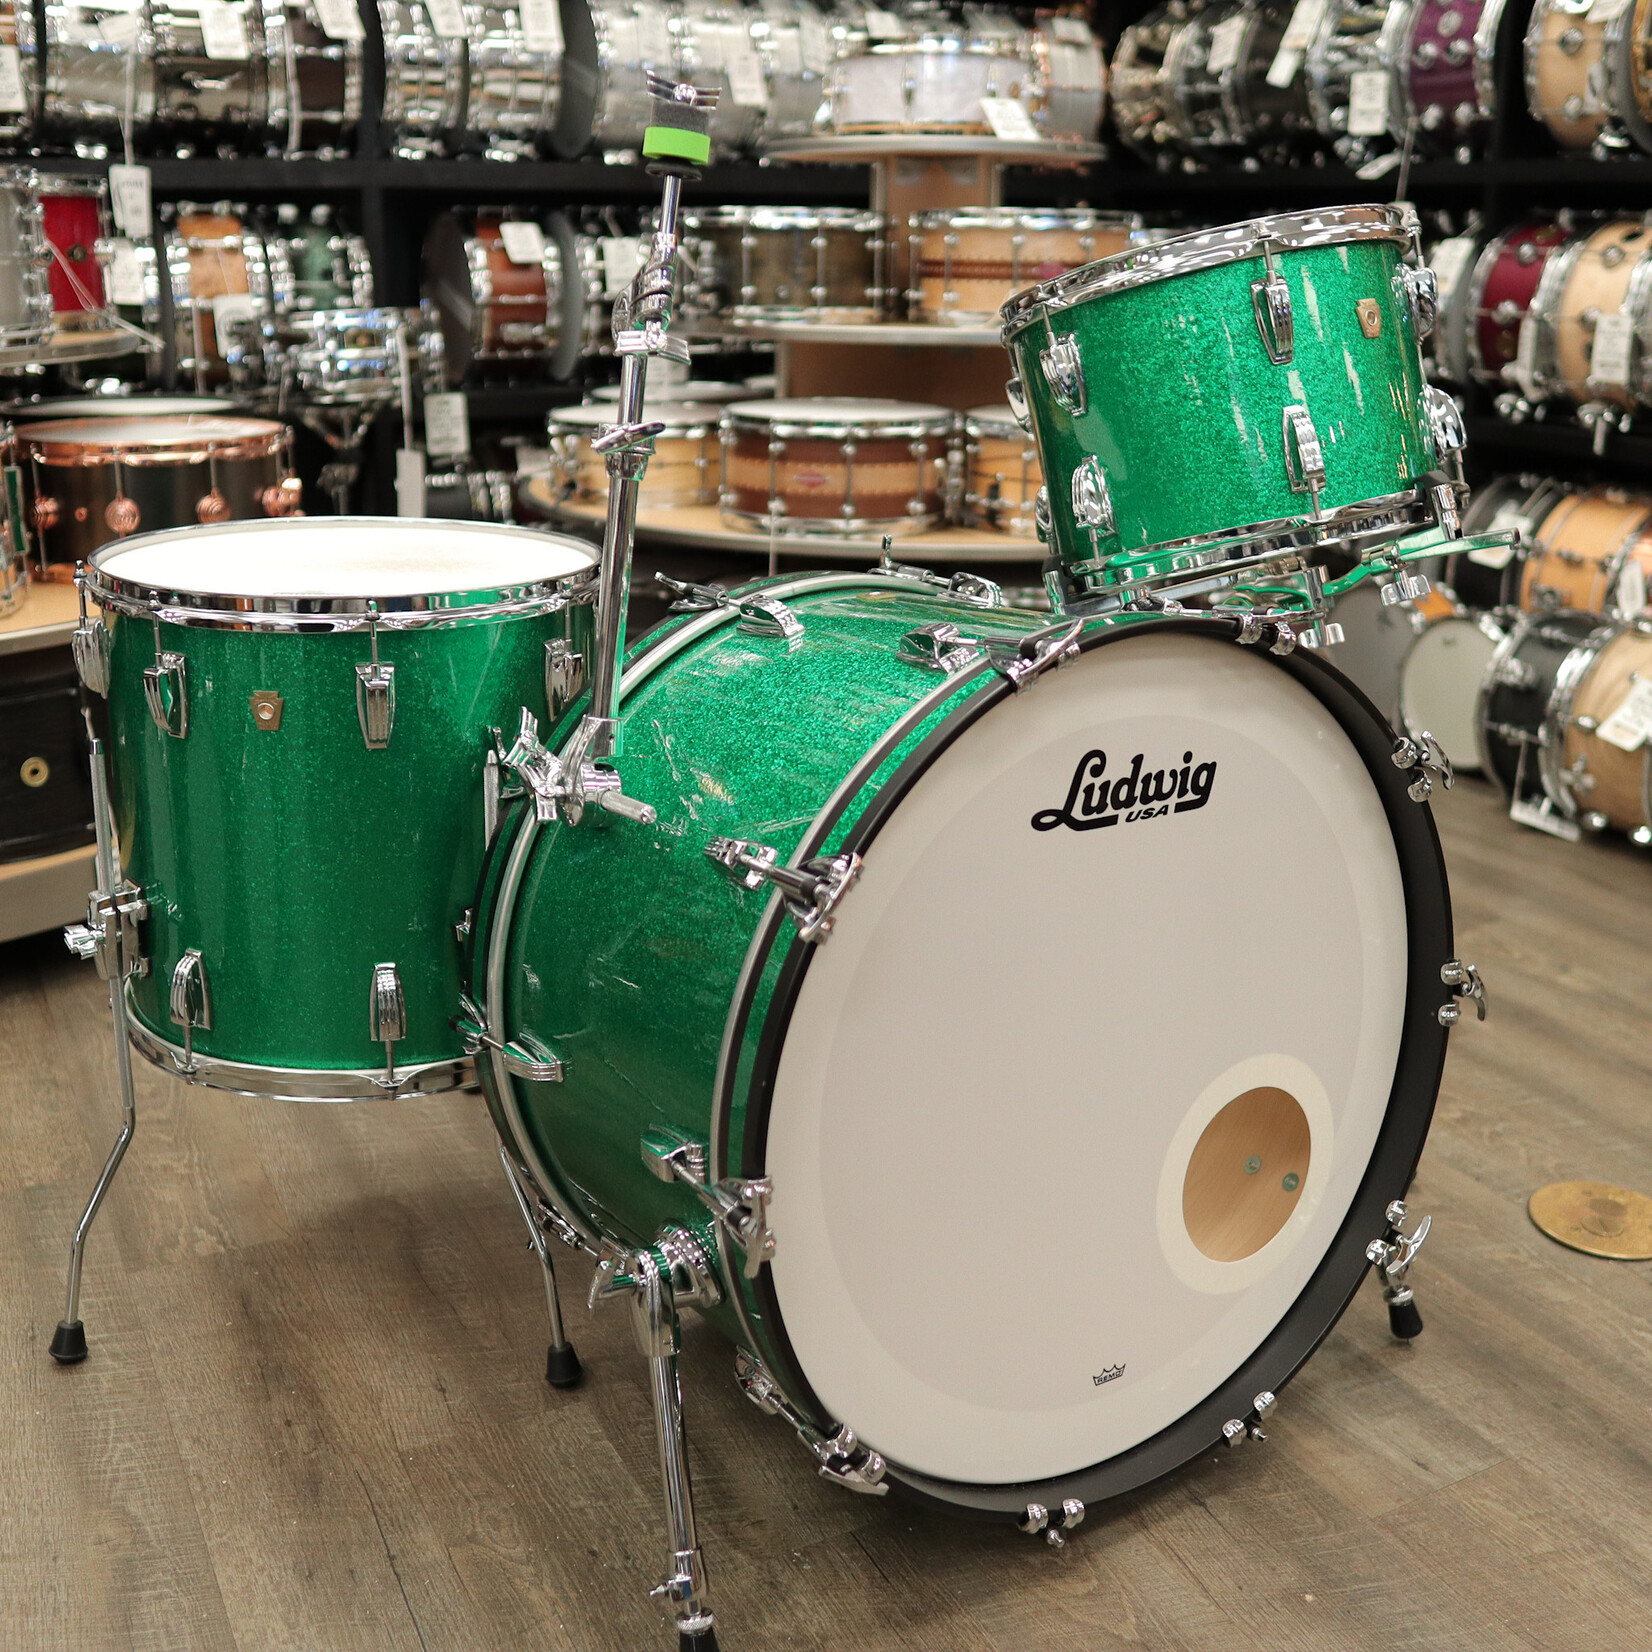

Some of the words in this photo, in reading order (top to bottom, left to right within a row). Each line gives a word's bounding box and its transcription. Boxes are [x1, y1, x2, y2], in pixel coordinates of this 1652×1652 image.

[1031, 749, 1217, 832] Ludwig
[1125, 804, 1169, 823] USA
[1097, 1369, 1122, 1384] REMO
